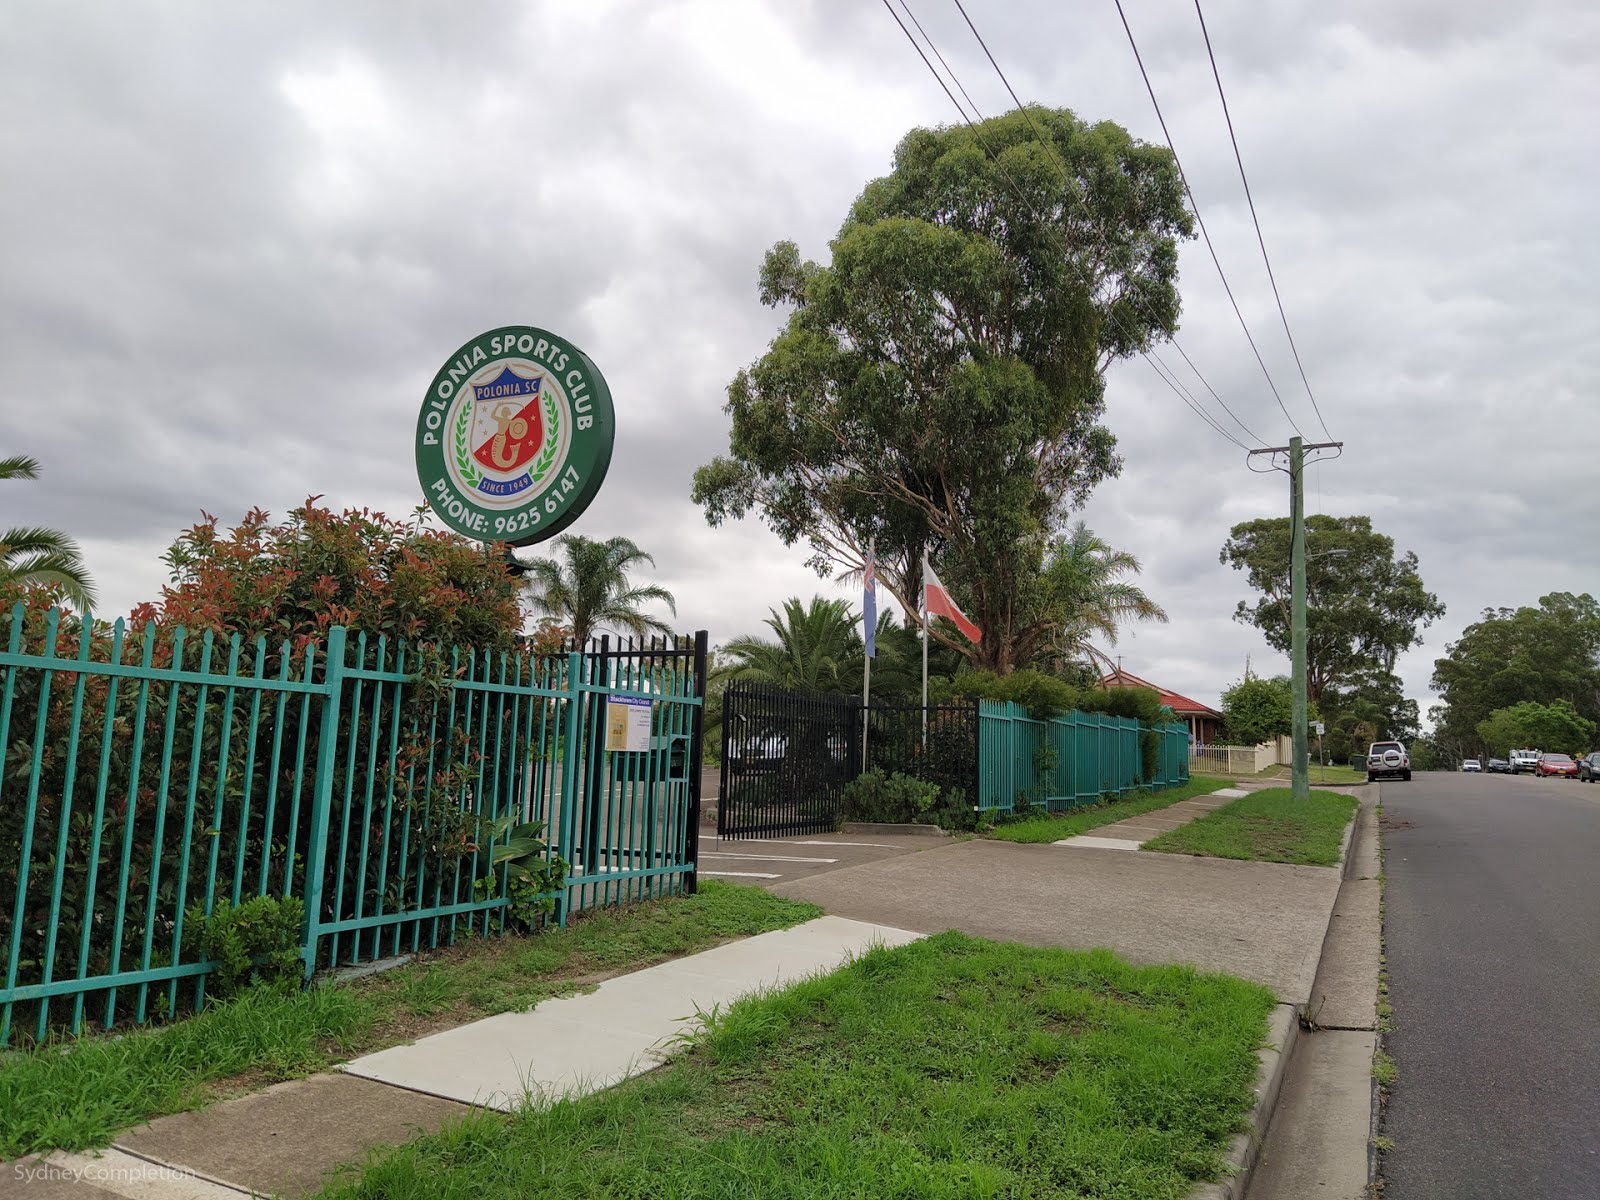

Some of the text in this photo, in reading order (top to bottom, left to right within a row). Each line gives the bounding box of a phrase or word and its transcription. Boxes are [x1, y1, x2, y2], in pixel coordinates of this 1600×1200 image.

[423, 334, 593, 445] POLONIA SPORTS CLUB
[477, 380, 537, 399] POLONIA SC
[431, 465, 580, 534] PHONE: 9625 6147
[481, 477, 529, 494] SINCE 1949
